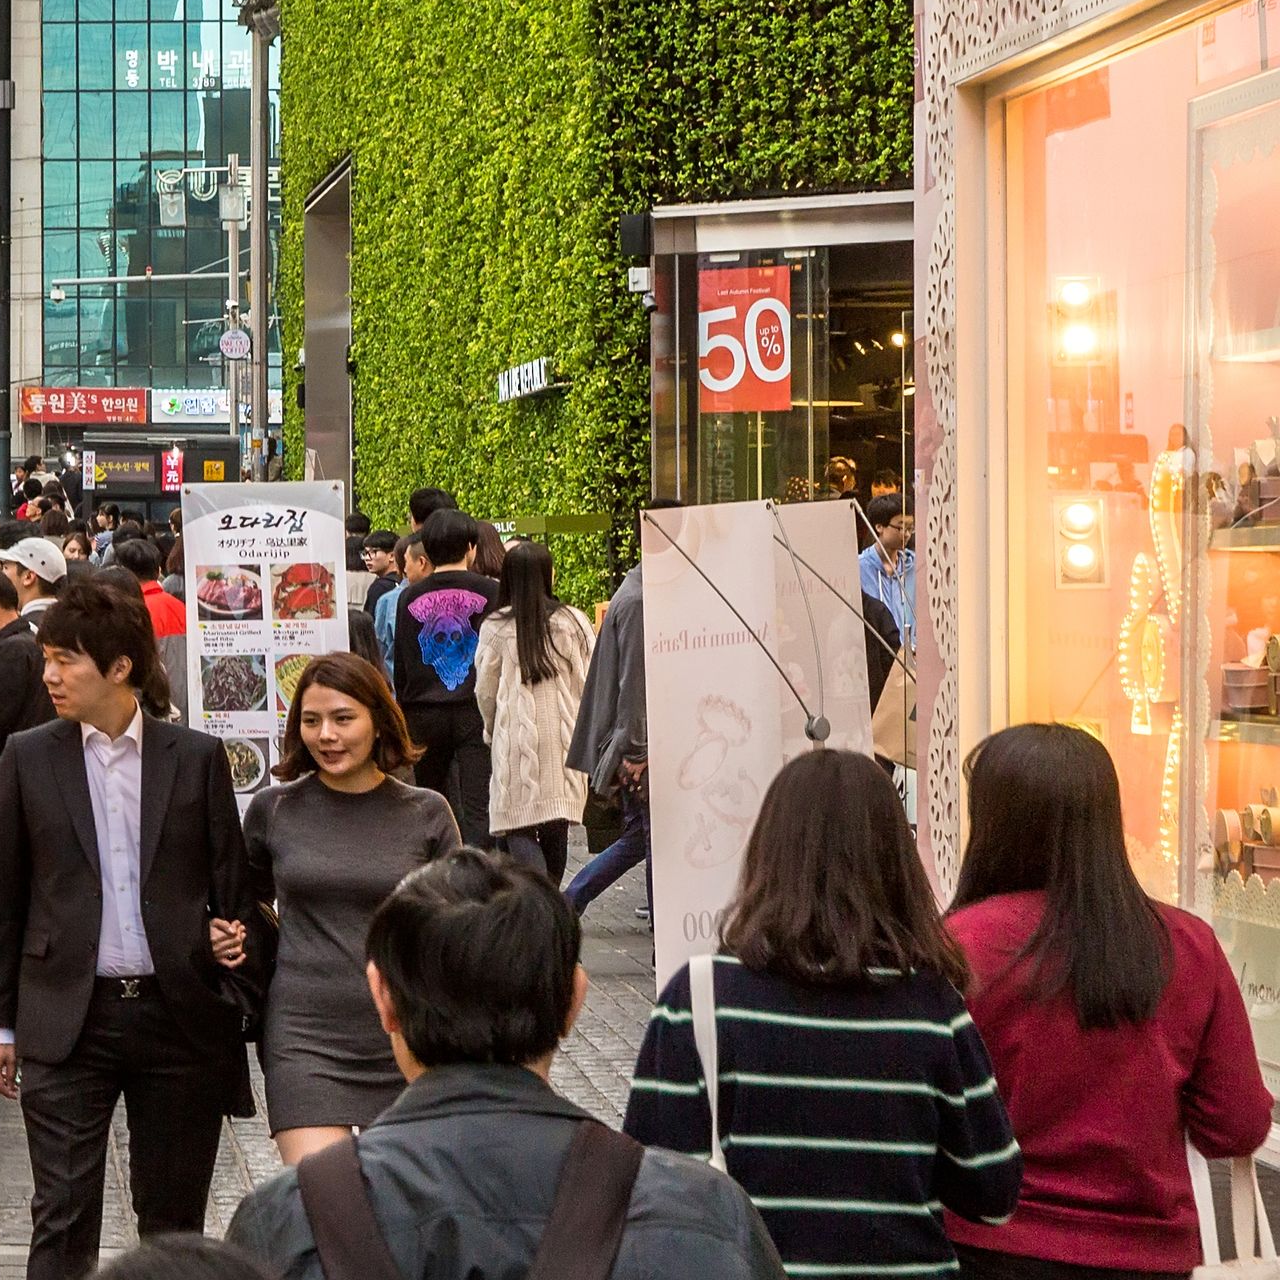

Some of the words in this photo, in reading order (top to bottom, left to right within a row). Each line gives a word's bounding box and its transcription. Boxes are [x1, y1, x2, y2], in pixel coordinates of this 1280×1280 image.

[160, 78, 177, 88] TEL
[759, 327, 769, 337] up
[771, 325, 779, 333] to
[698, 297, 791, 392] 50
[761, 335, 781, 357] %
[101, 397, 138, 412] 한의원
[239, 549, 290, 559] Odarijip
